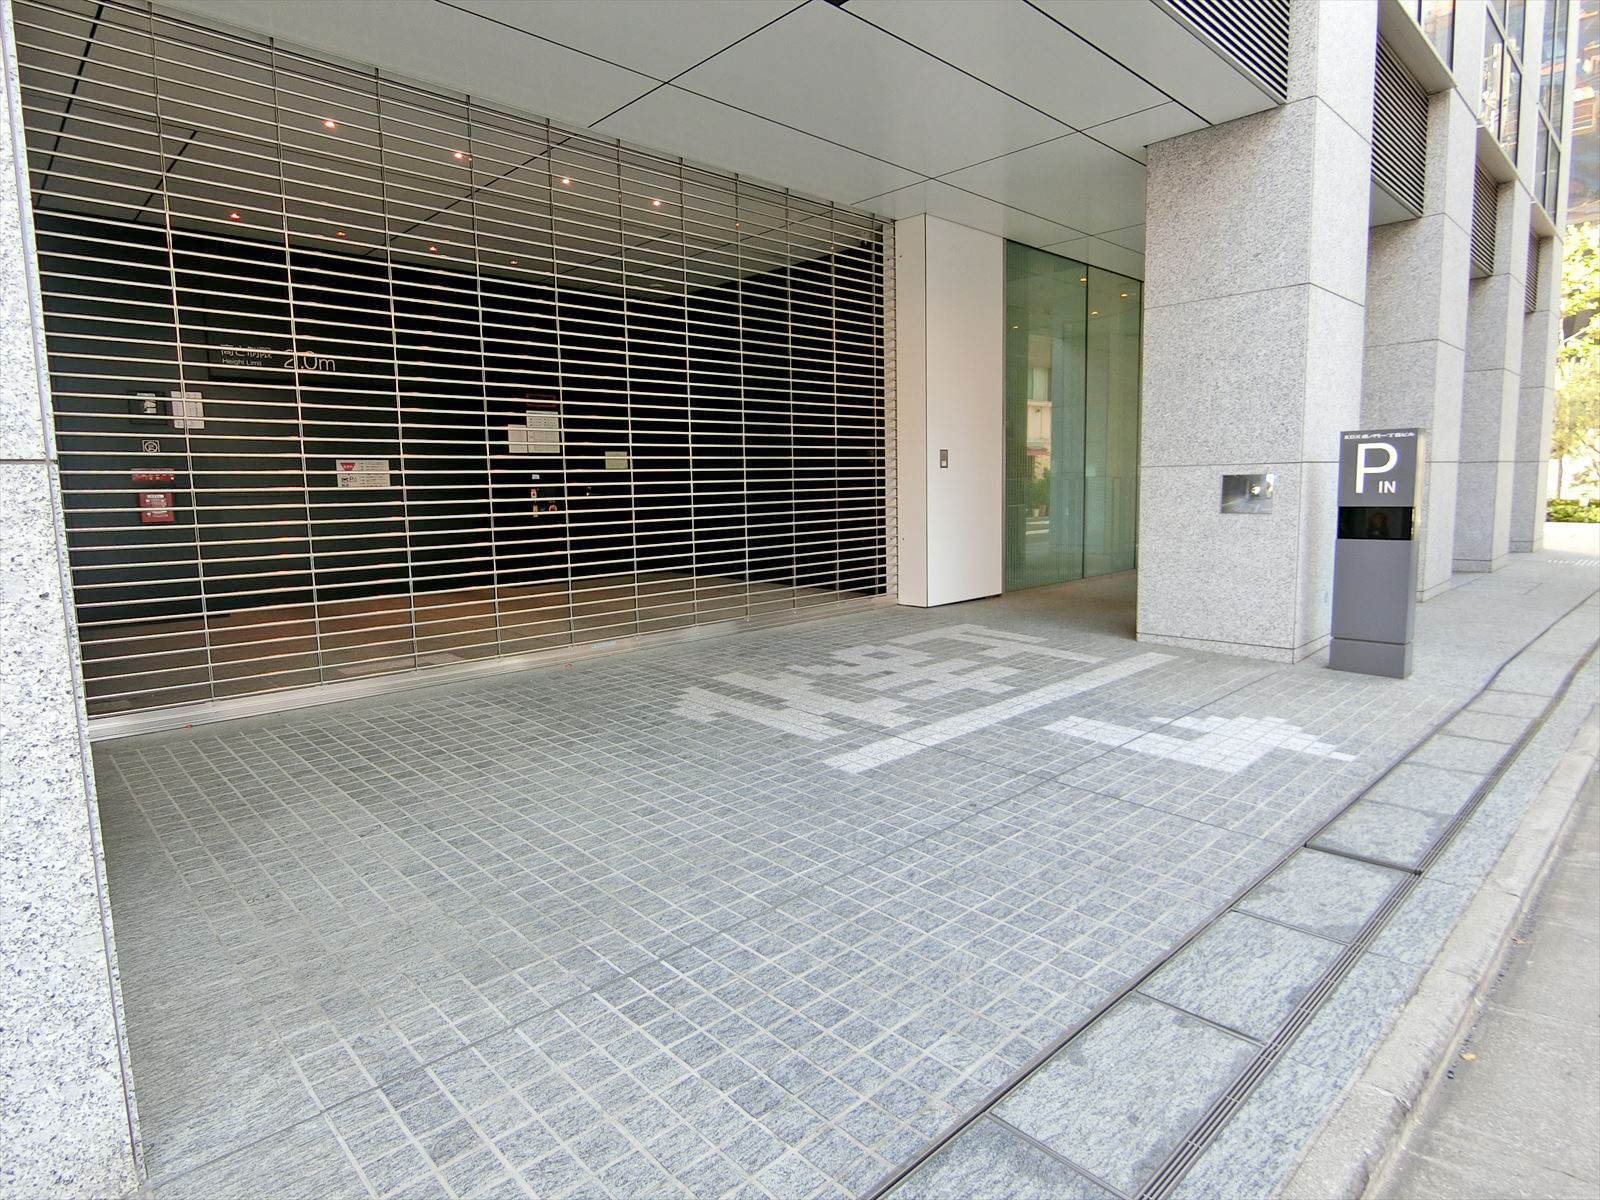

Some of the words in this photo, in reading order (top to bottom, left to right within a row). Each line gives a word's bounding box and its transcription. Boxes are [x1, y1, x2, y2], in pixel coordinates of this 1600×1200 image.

[222, 358, 245, 367] Height
[246, 359, 263, 367] Limit
[283, 349, 336, 371] 2.0m
[1356, 442, 1398, 494] P
[1378, 480, 1396, 493] IN
[670, 624, 1107, 741] 止まれ
